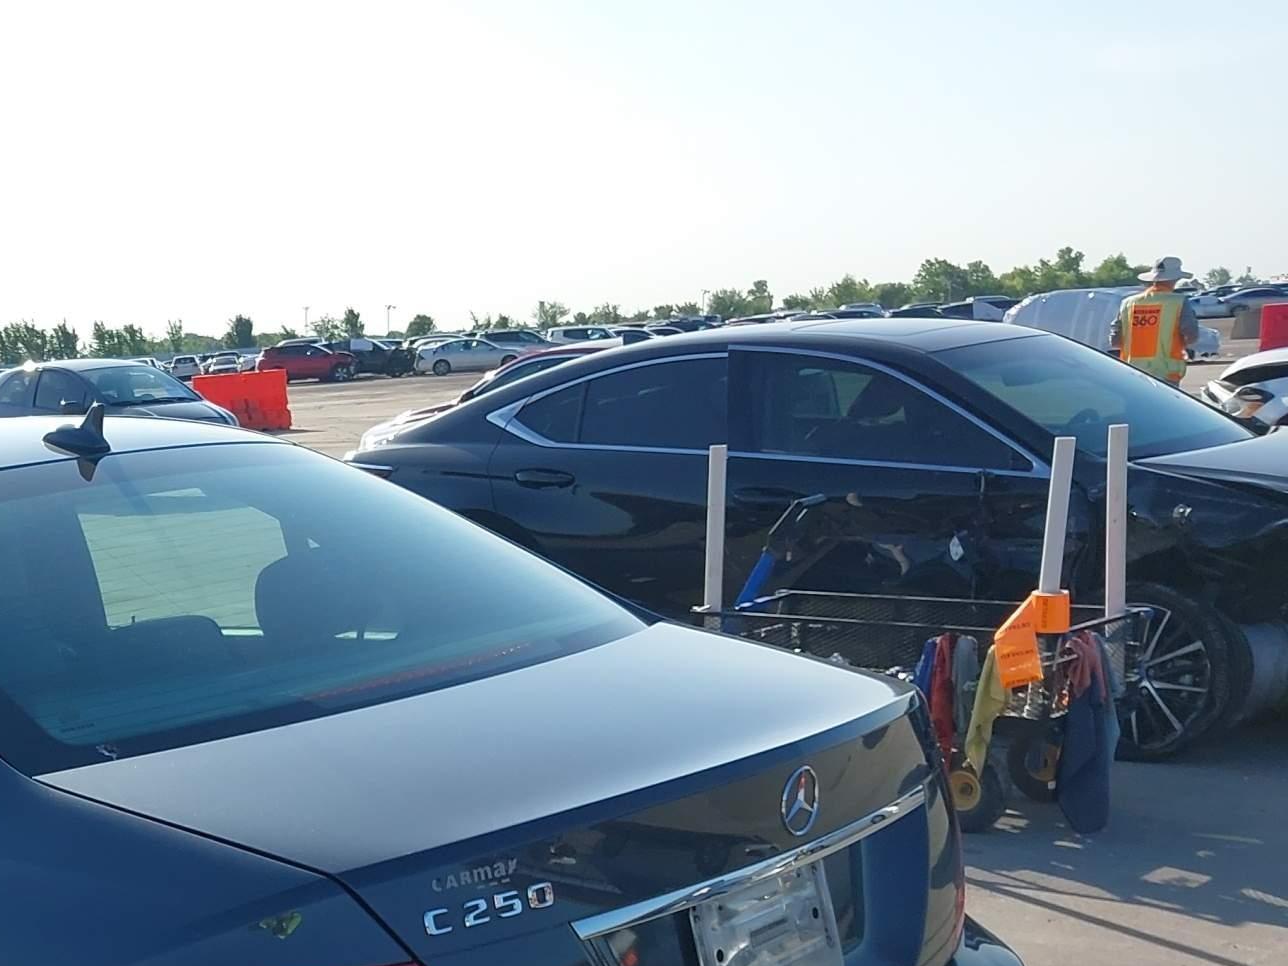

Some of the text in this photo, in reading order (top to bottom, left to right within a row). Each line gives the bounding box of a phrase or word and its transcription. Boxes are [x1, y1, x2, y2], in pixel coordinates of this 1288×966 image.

[1132, 315, 1159, 327] 360
[423, 882, 554, 936] C 250
